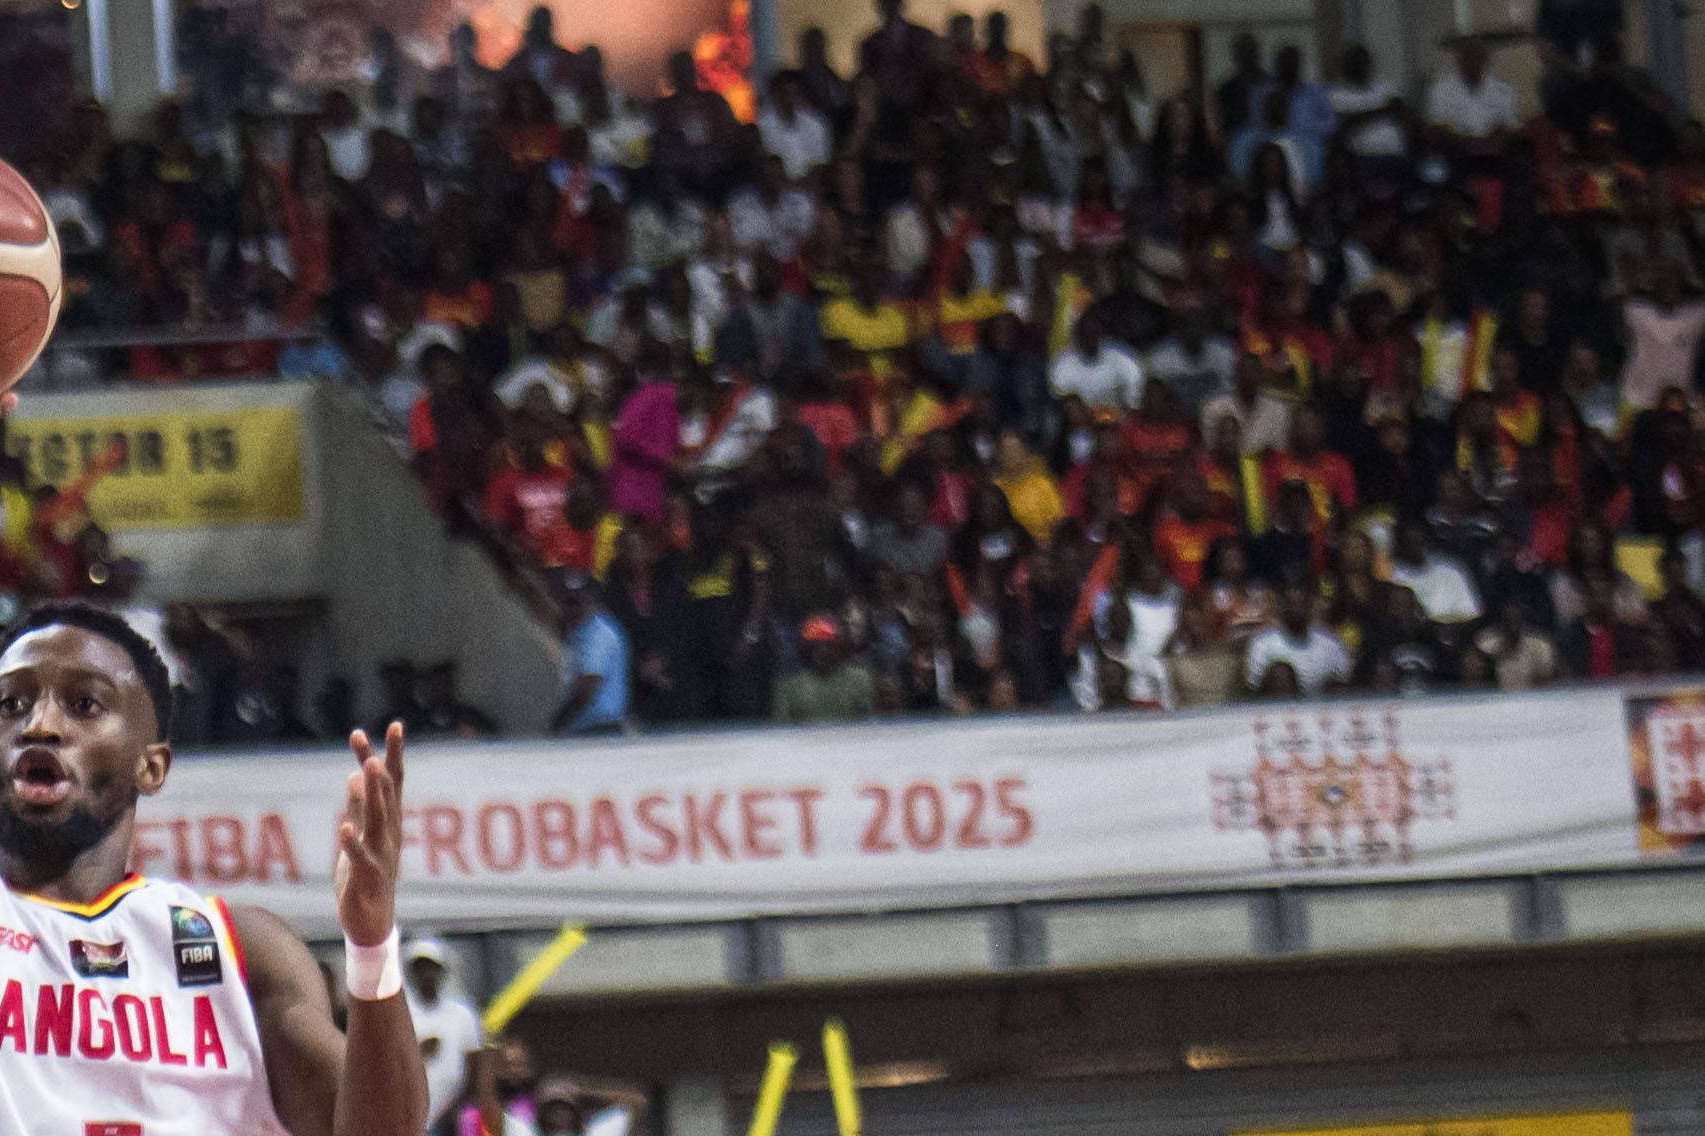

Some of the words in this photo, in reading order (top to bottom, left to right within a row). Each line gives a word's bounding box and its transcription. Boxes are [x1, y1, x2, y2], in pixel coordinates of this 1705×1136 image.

[133, 813, 300, 885] FIBA
[336, 787, 824, 879] FROBASKET
[857, 778, 1035, 854] 2025
[181, 945, 213, 965] FIBA
